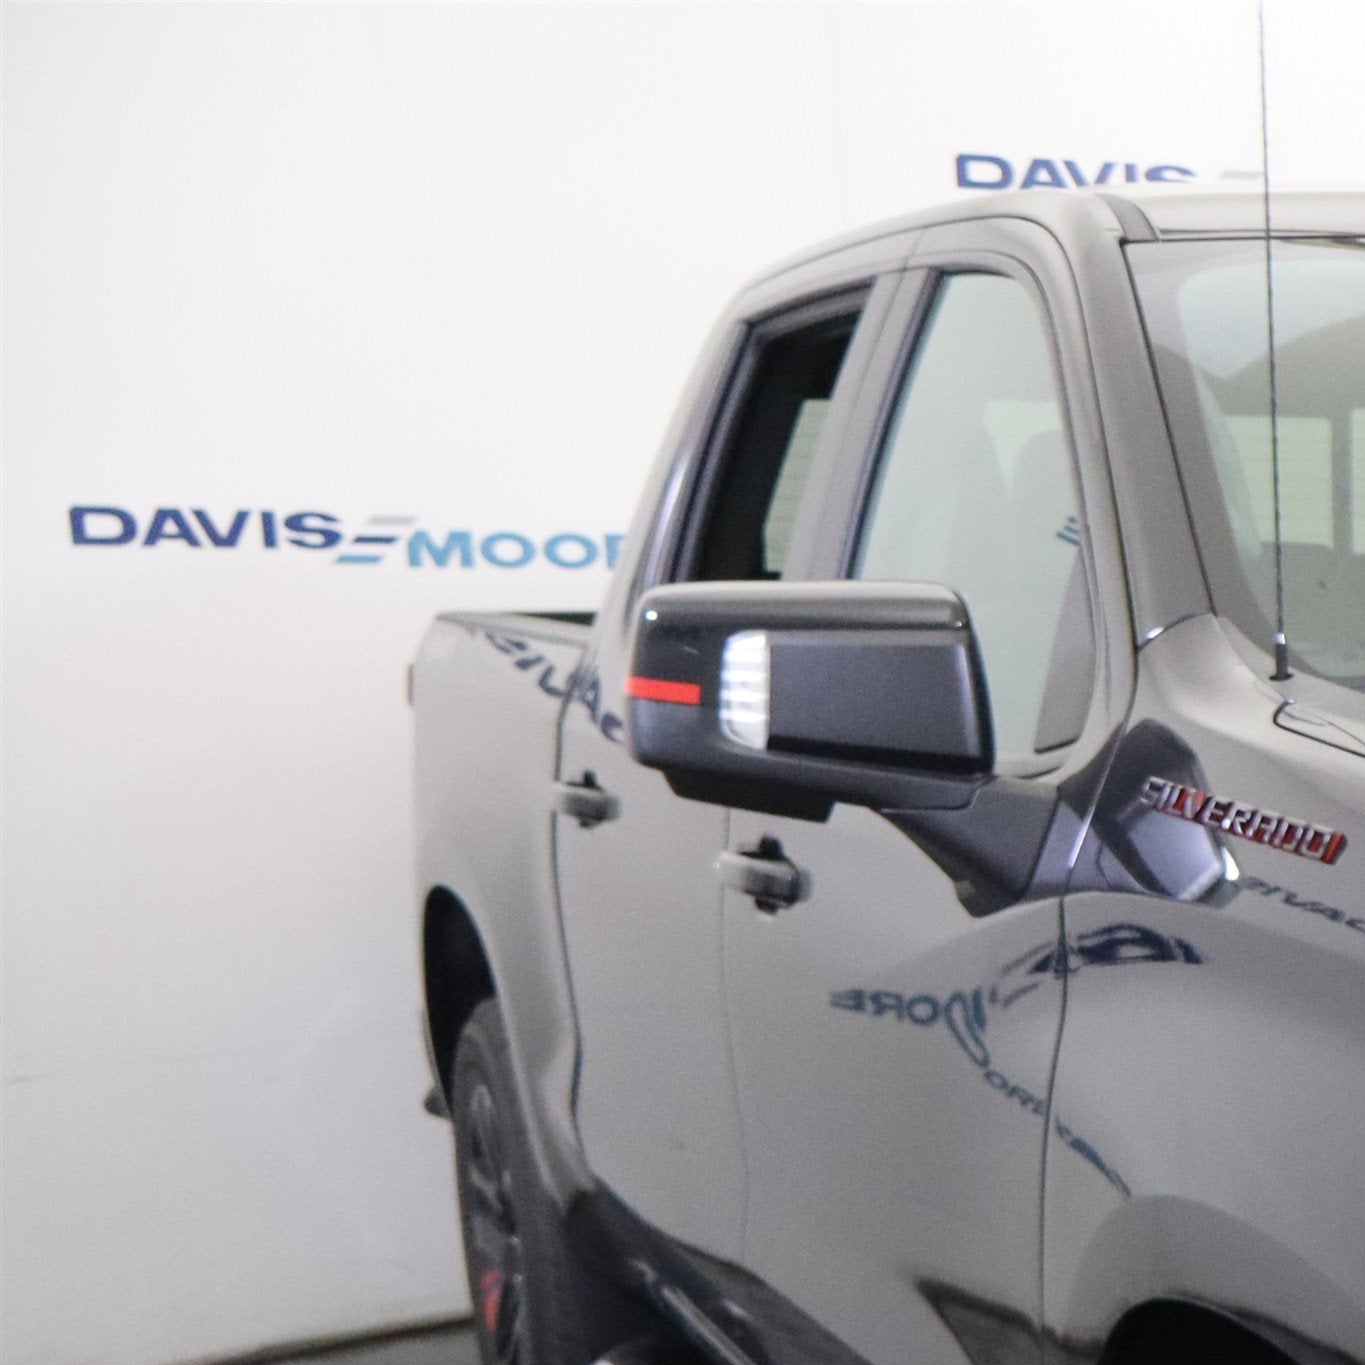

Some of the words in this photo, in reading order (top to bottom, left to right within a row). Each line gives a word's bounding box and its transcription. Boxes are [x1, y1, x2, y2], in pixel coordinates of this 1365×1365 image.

[70, 504, 345, 550] DAVIS
[406, 528, 625, 570] MOO
[1140, 776, 1347, 865] SILVERADO
